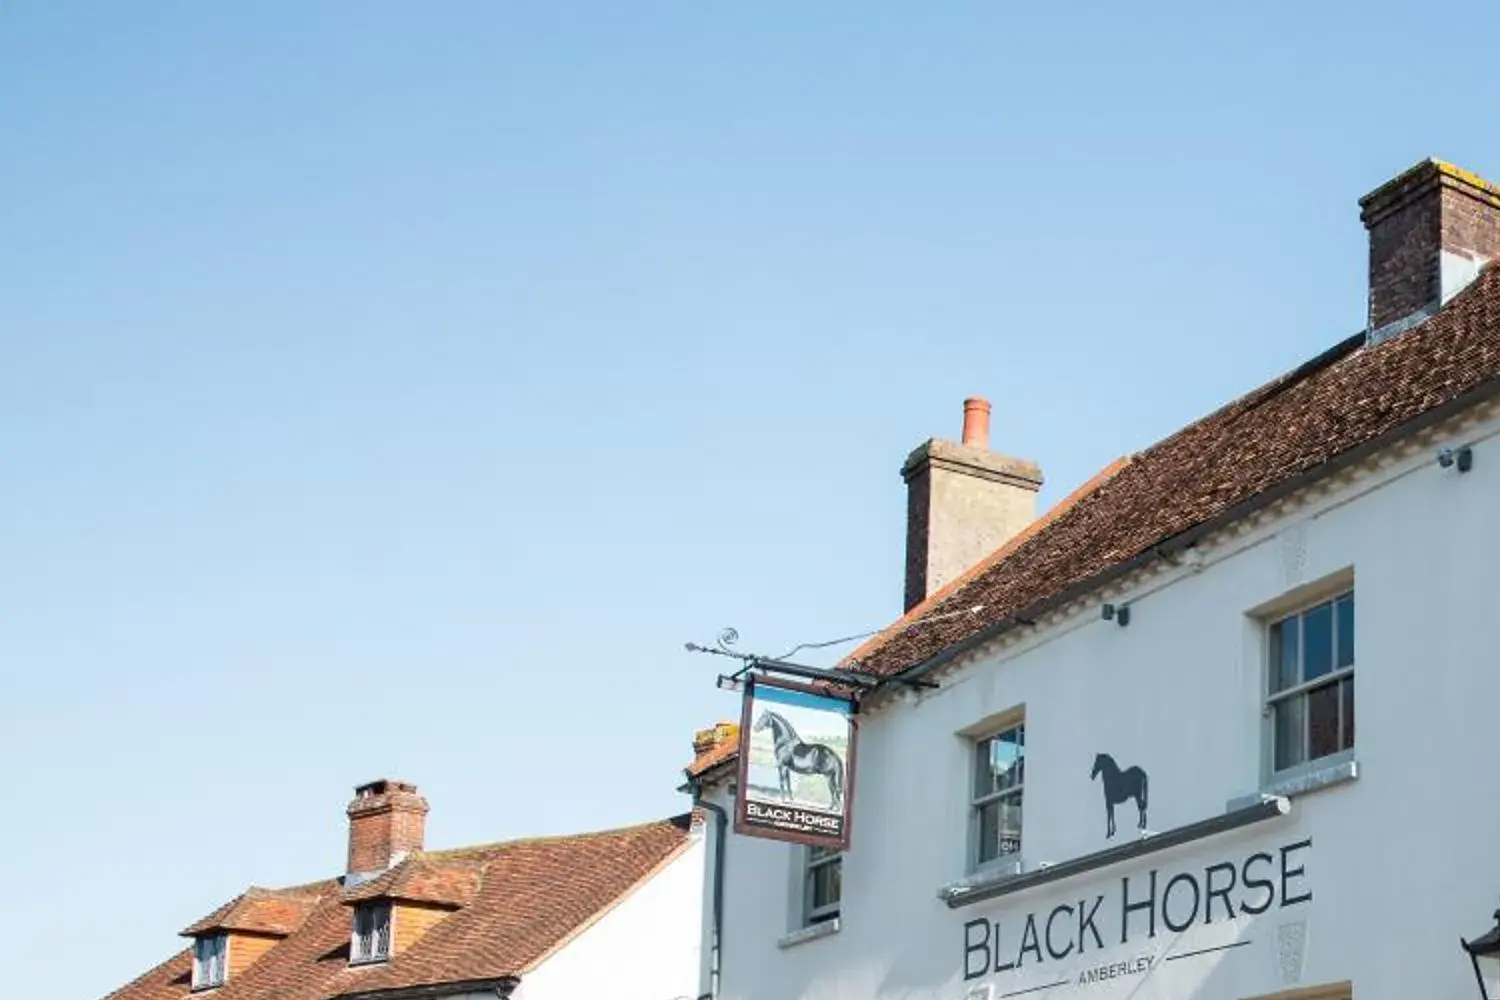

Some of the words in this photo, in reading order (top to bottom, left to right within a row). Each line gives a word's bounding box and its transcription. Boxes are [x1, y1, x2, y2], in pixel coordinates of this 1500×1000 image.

[747, 804, 792, 821] BLACK
[794, 811, 840, 829] HORSE
[963, 895, 1104, 980] BLACK
[1121, 836, 1313, 943] HORSE
[1078, 955, 1156, 985] AMBERLEY
